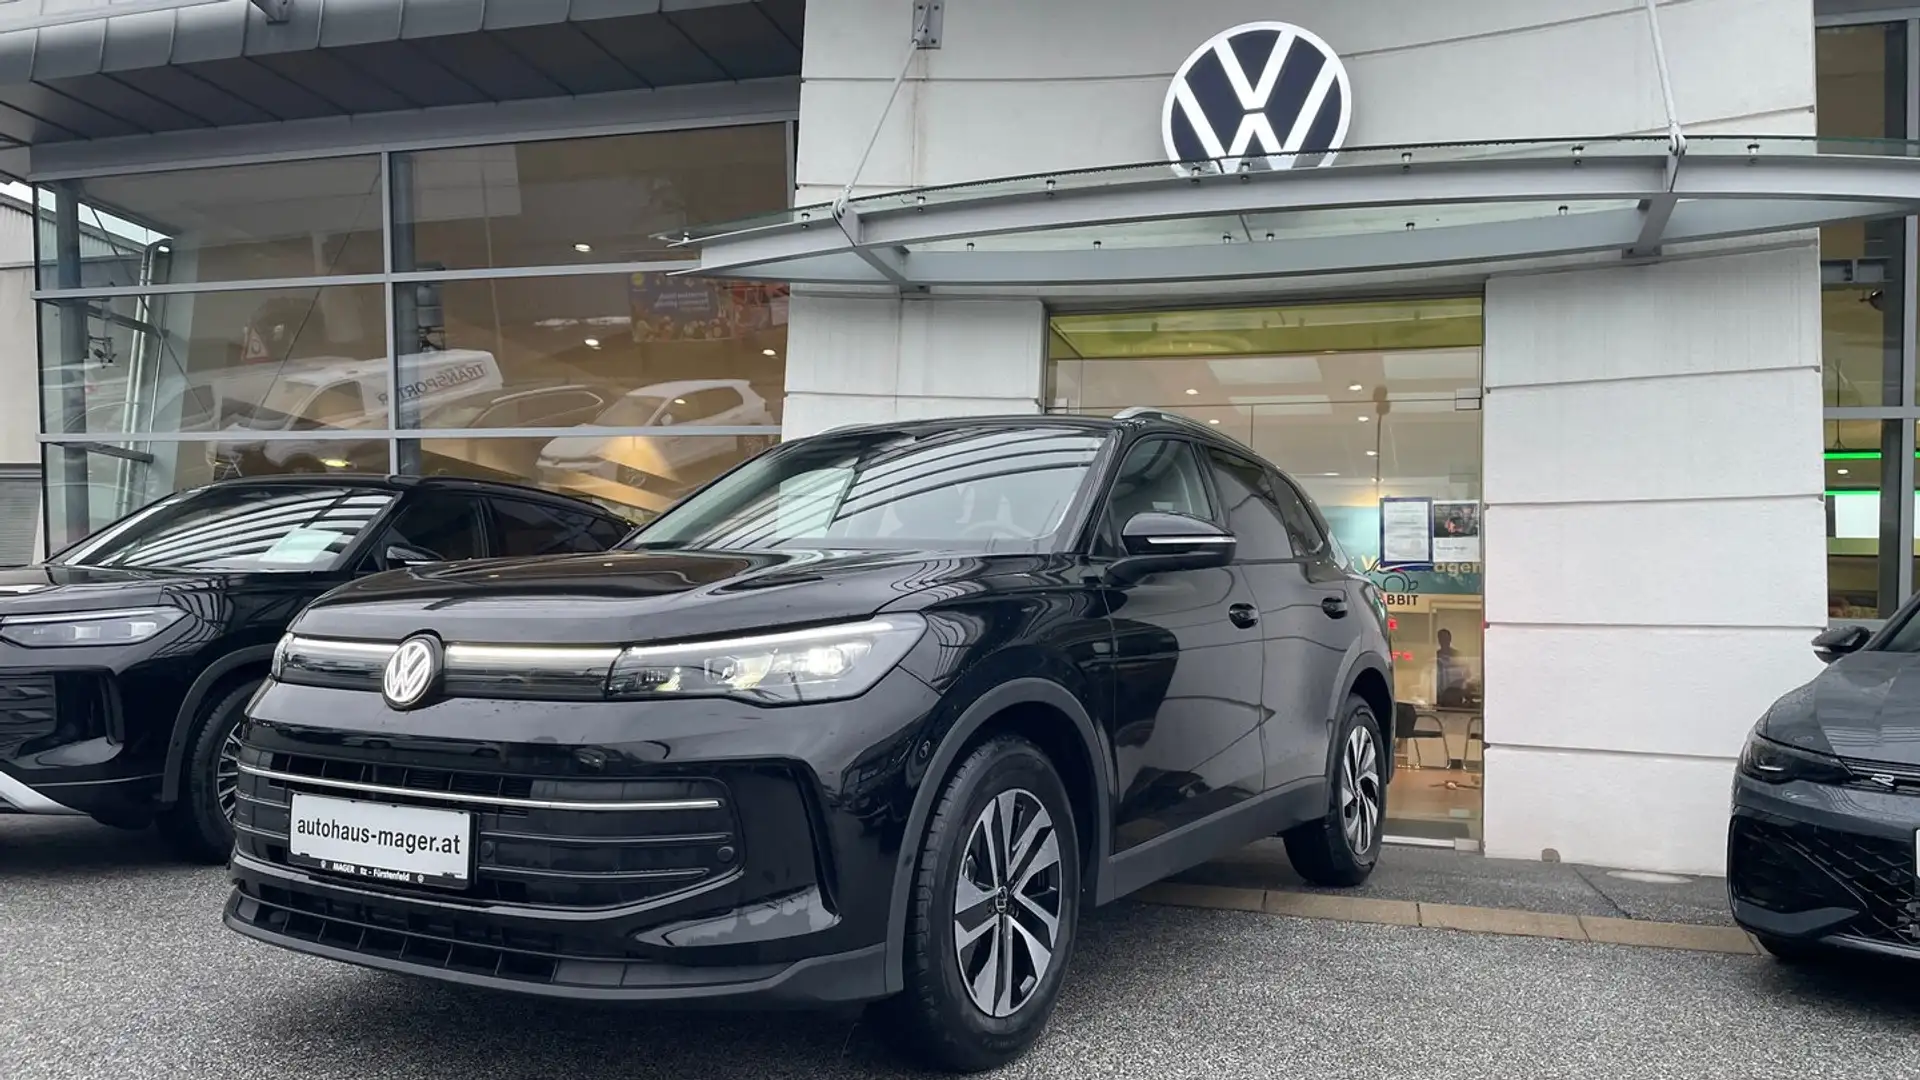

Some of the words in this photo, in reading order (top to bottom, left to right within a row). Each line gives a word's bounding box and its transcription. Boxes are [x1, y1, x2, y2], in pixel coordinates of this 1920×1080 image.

[1386, 594, 1419, 606] BBIT
[297, 818, 461, 854] autohaus-mager.at
[332, 862, 355, 874] MAGER
[373, 868, 411, 882] Fürstenfeld
